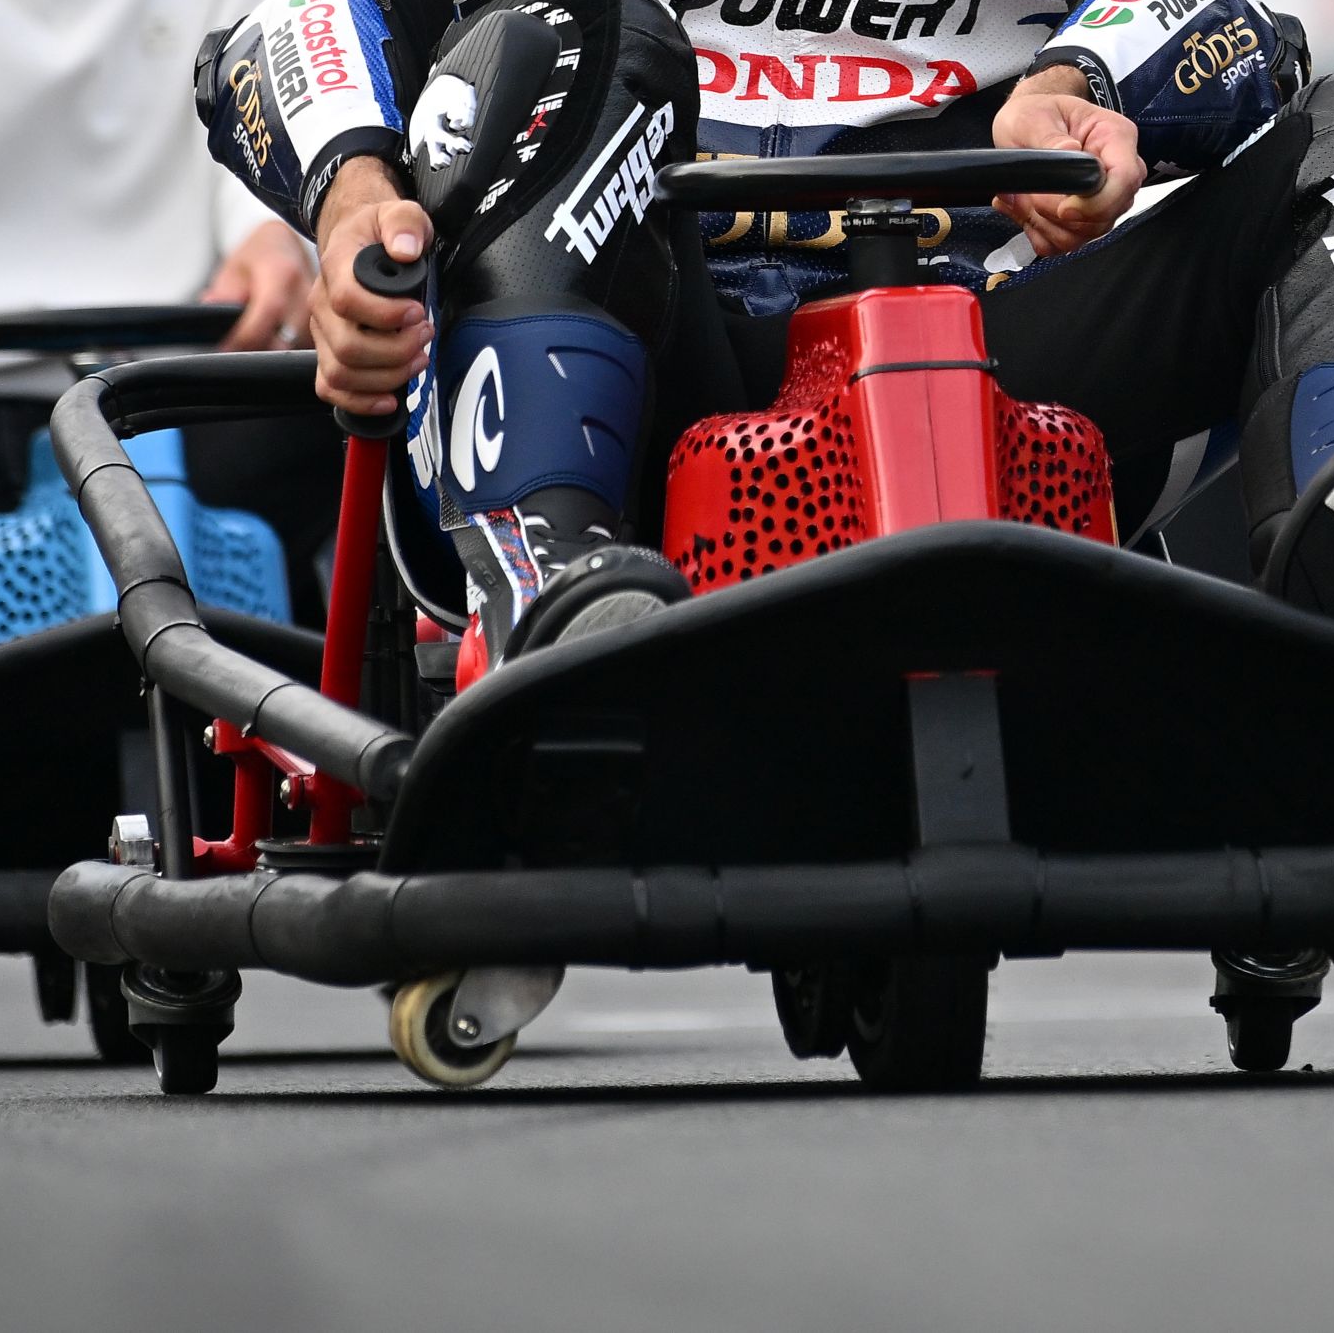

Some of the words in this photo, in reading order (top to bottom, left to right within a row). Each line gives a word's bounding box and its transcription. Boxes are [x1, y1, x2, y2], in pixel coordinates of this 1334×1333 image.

[299, 3, 358, 94] Castrol
[697, 45, 979, 108] ONDA
[232, 122, 262, 187] SPORTS
